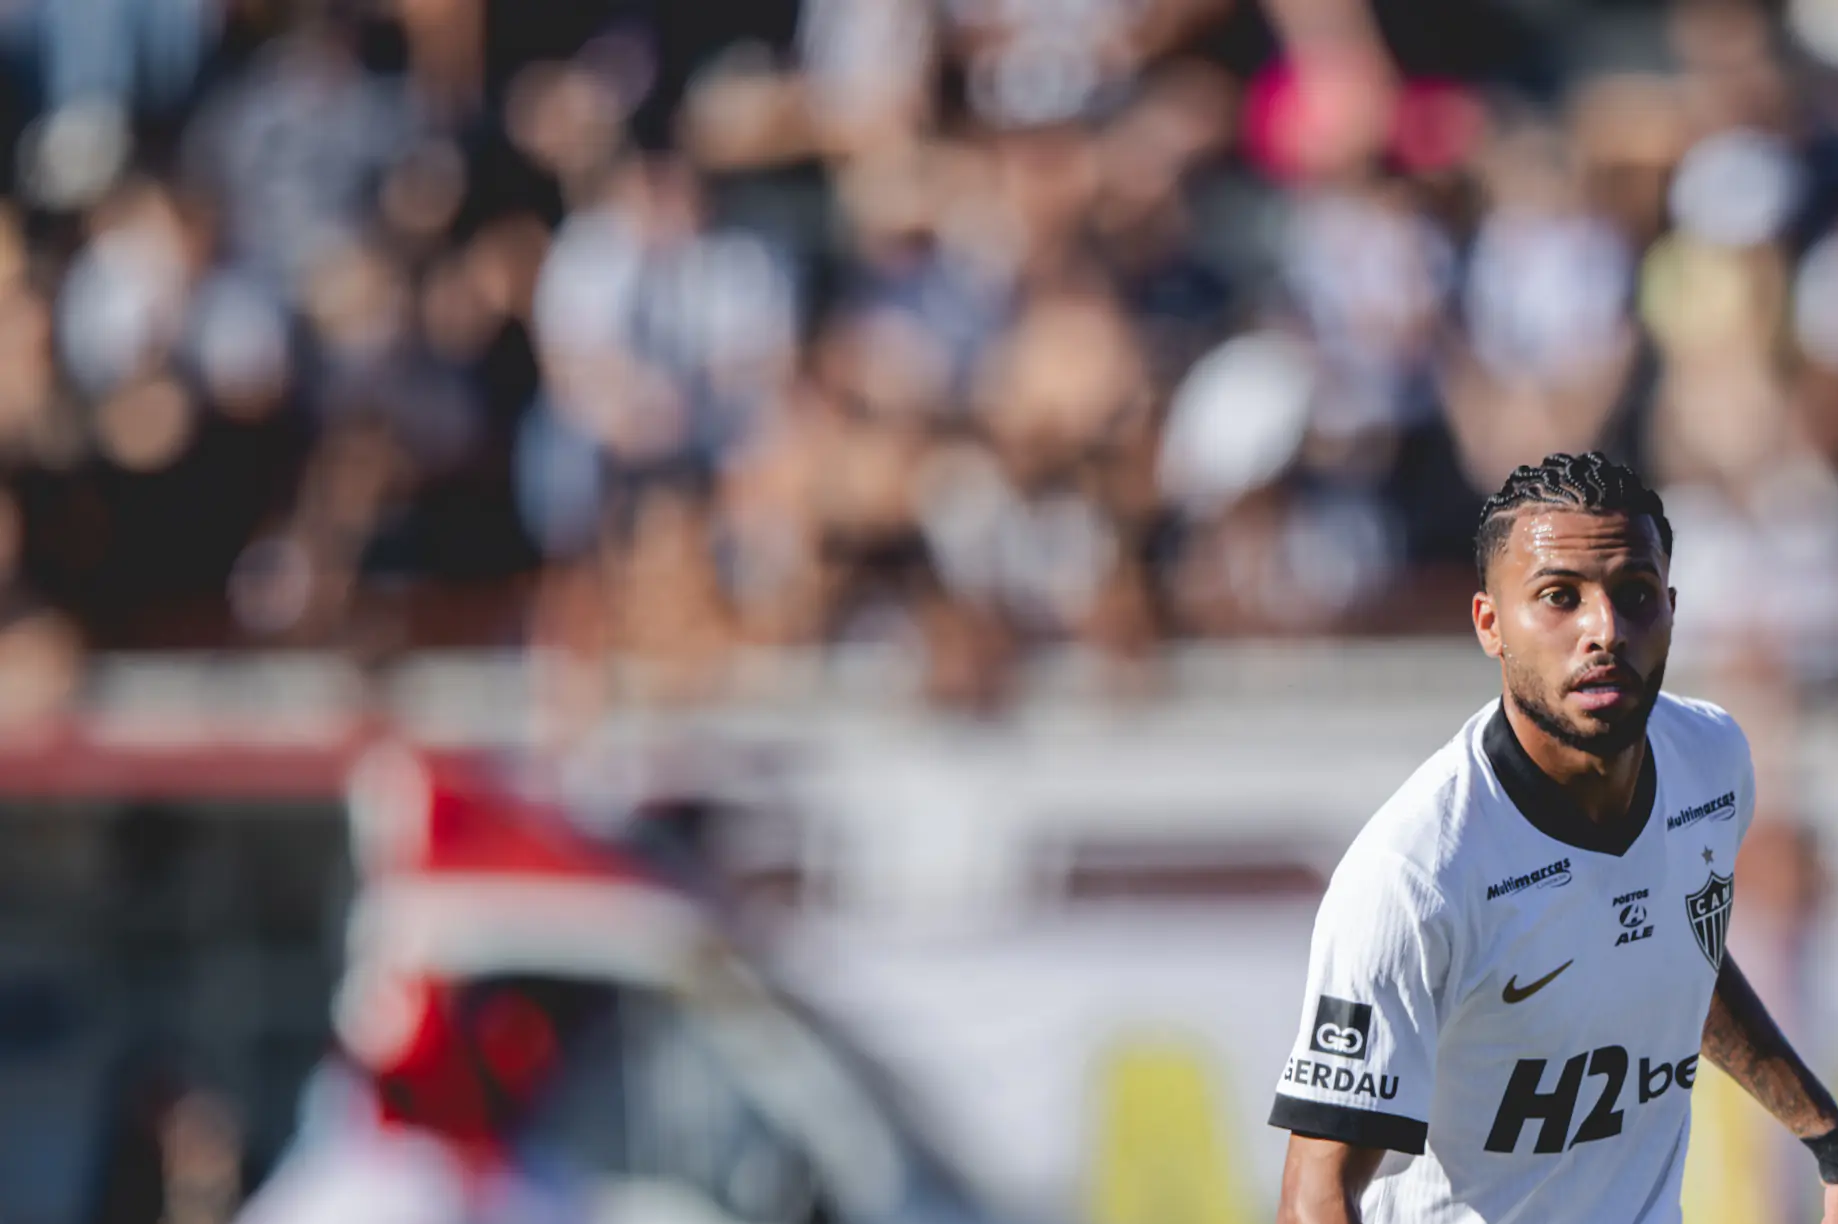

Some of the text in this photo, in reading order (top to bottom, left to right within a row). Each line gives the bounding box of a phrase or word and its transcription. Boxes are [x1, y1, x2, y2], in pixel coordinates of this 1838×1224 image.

[1667, 791, 1735, 832] Multimarcas
[1486, 857, 1571, 901] Multimarcas
[1612, 888, 1649, 908] POSTOS
[1614, 925, 1655, 947] ALE
